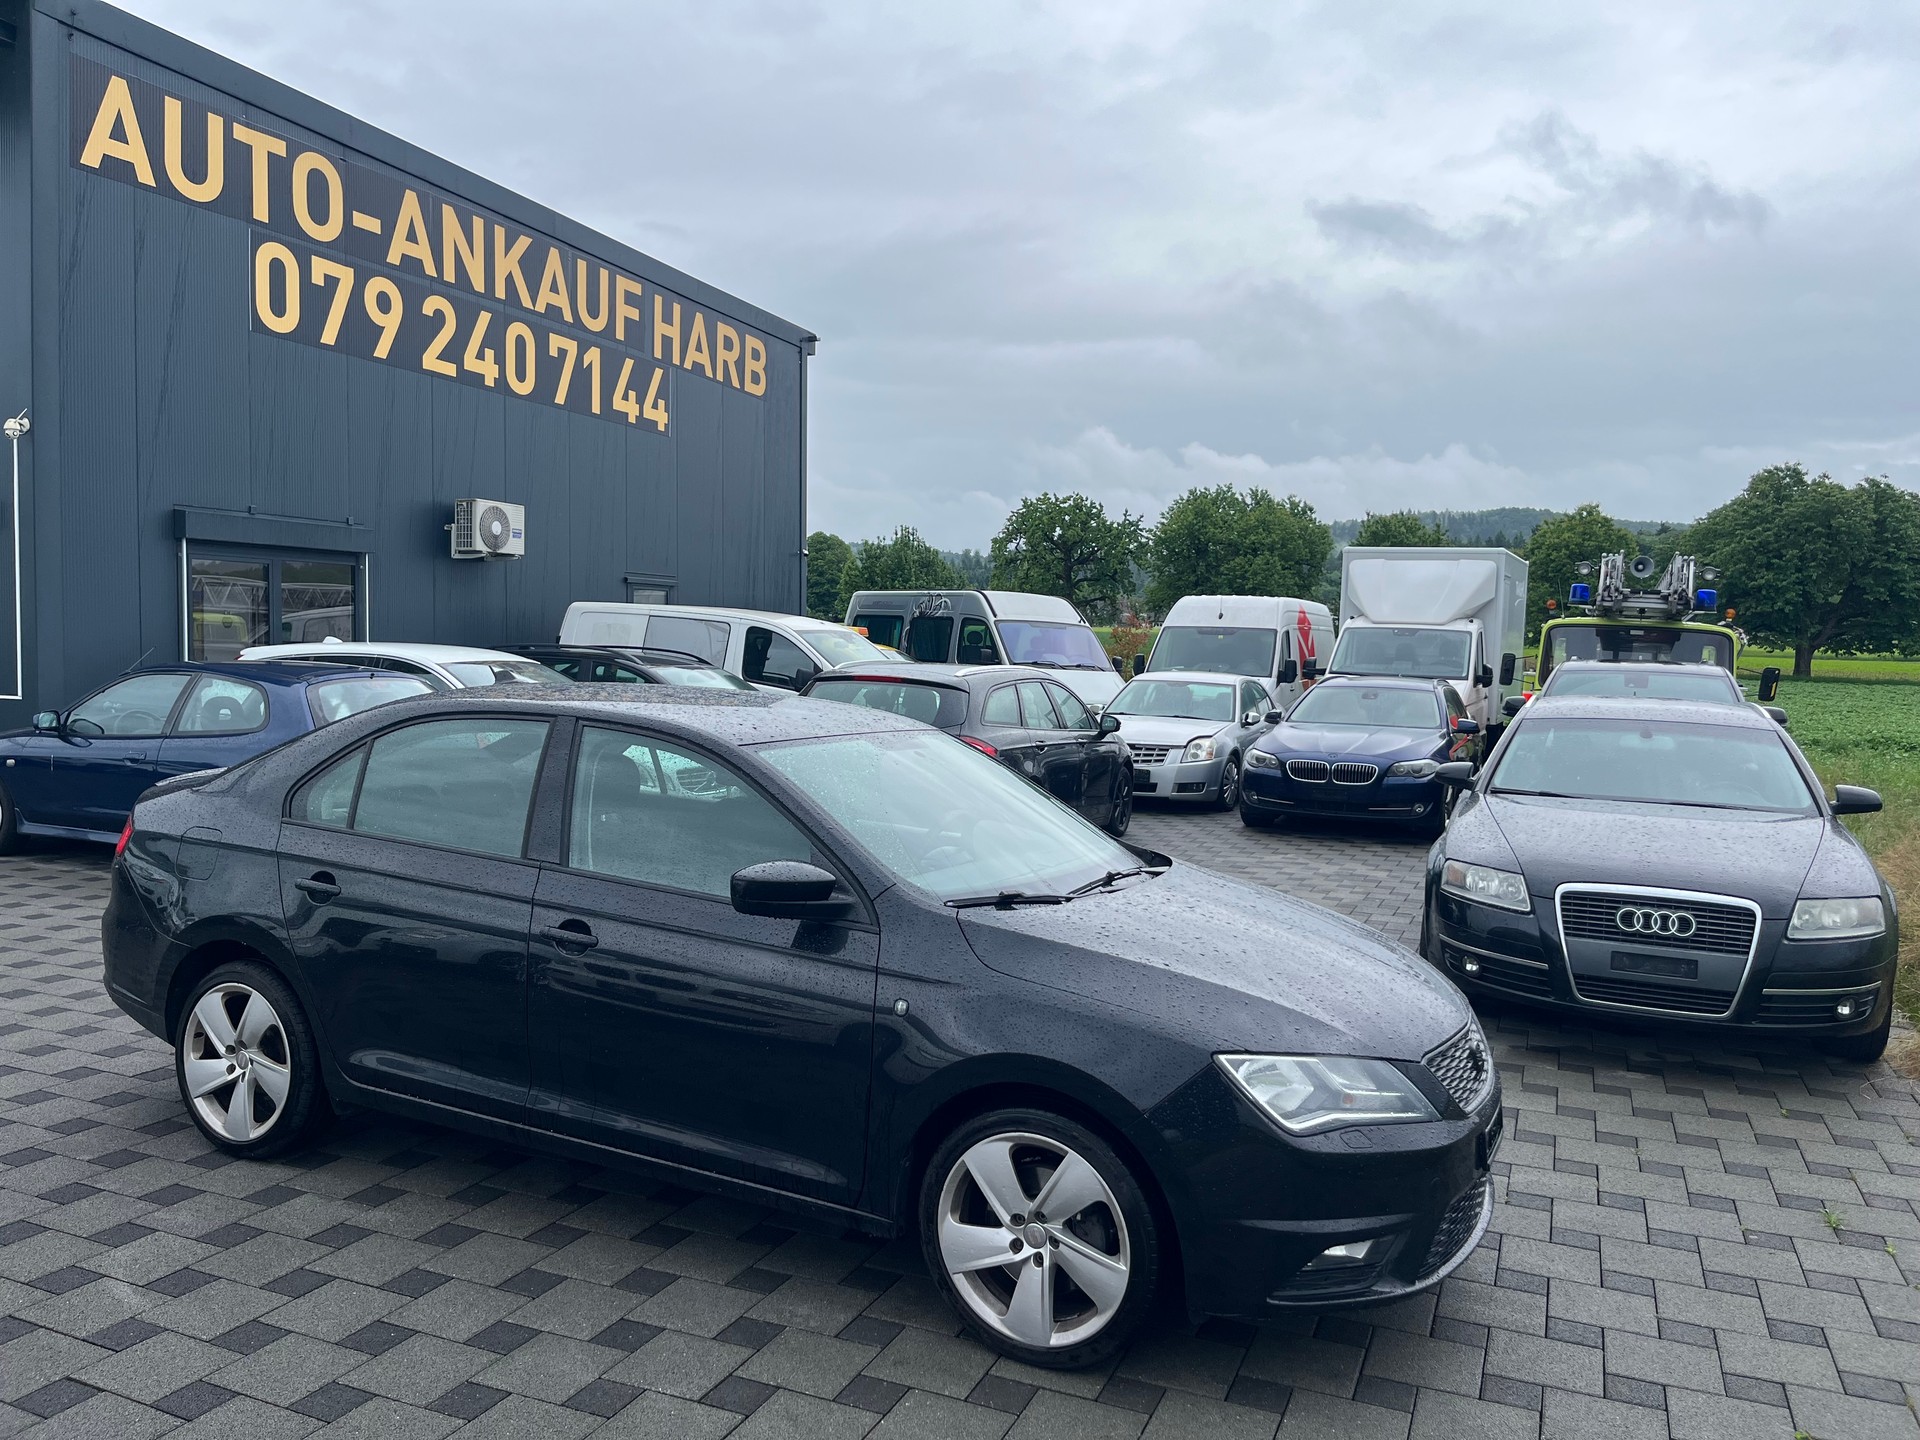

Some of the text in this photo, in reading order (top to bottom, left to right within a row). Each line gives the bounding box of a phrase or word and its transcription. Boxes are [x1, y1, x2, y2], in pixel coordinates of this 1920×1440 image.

[80, 75, 768, 398] AUTO-ANKAUF HARB
[255, 241, 669, 432] 079 240 7144
